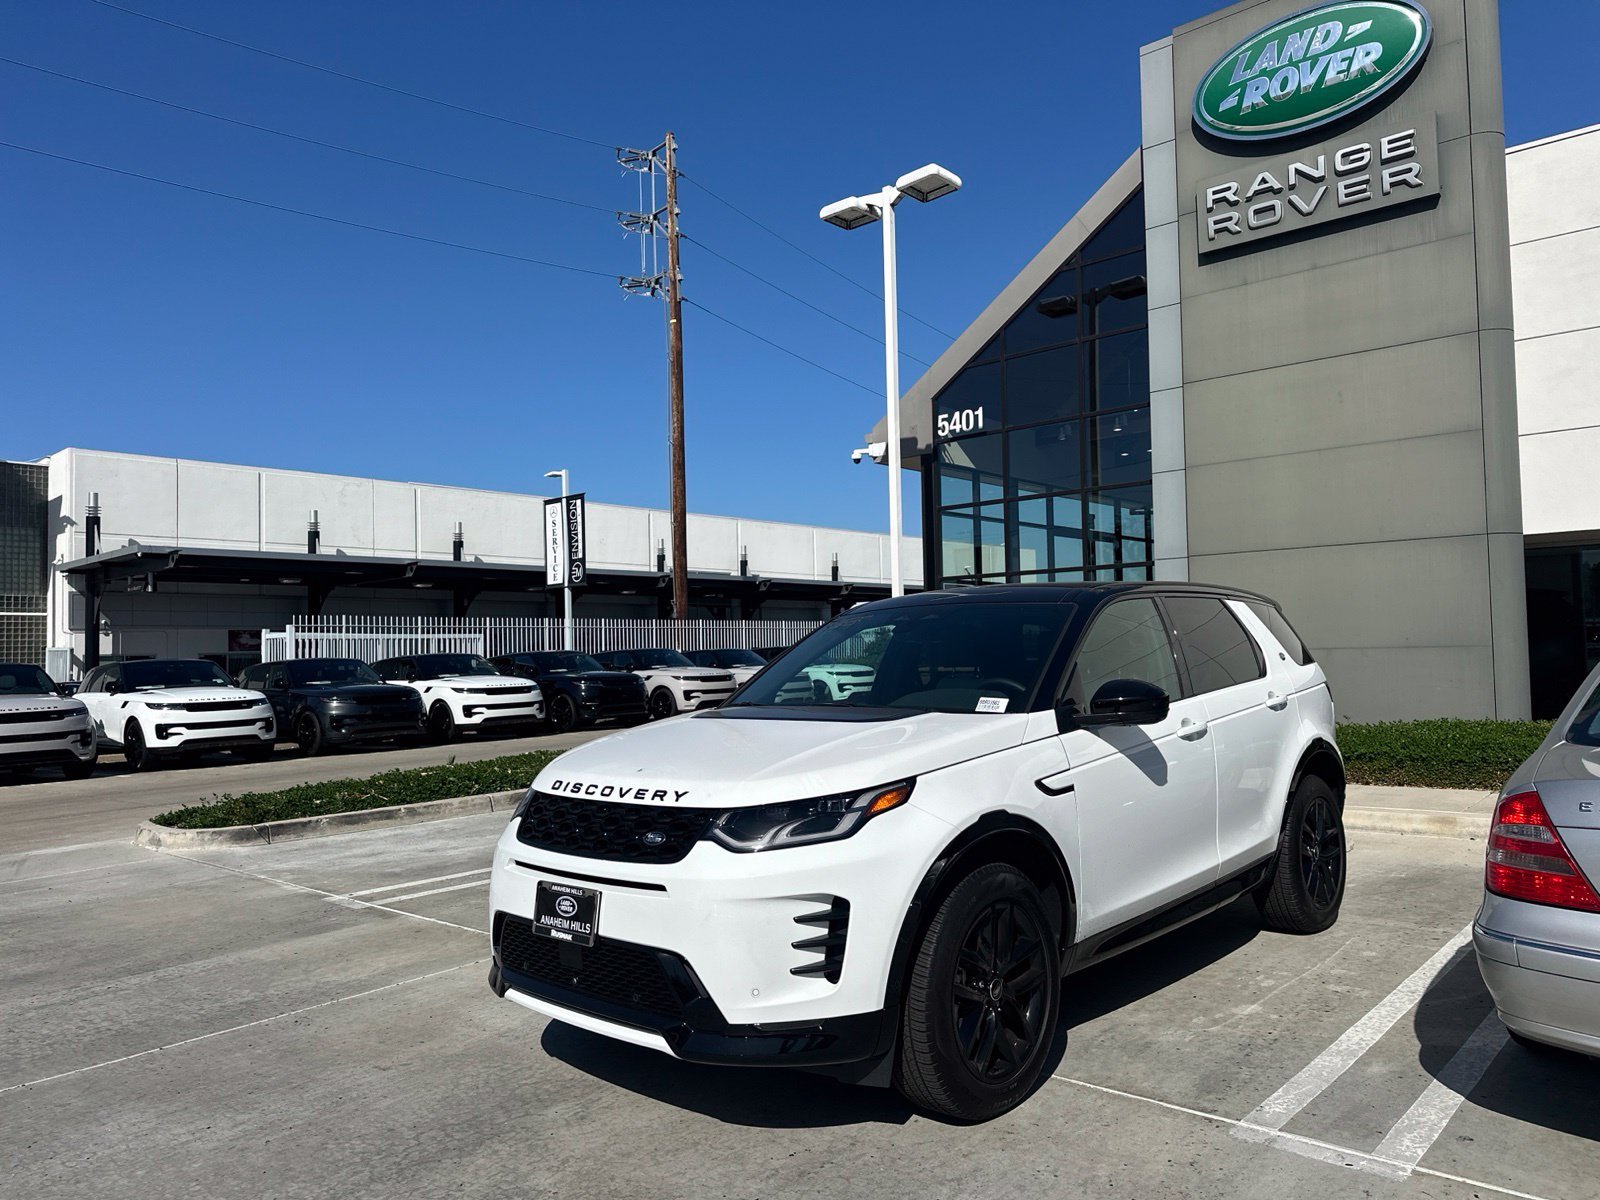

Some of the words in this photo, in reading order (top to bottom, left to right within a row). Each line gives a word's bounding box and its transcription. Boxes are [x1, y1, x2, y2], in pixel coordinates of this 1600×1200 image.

[1228, 20, 1343, 86] LAND
[1239, 41, 1383, 115] ROVER
[1206, 128, 1417, 213] RANGE
[1206, 161, 1425, 241] ROVER
[937, 406, 984, 436] 5401
[569, 499, 579, 560] ENVISION
[551, 780, 689, 802] DISCOVERY
[551, 884, 570, 893] ANAHEIM
[570, 888, 583, 896] HILLS
[540, 914, 570, 930] ANAHEIM
[570, 920, 591, 934] HILLS
